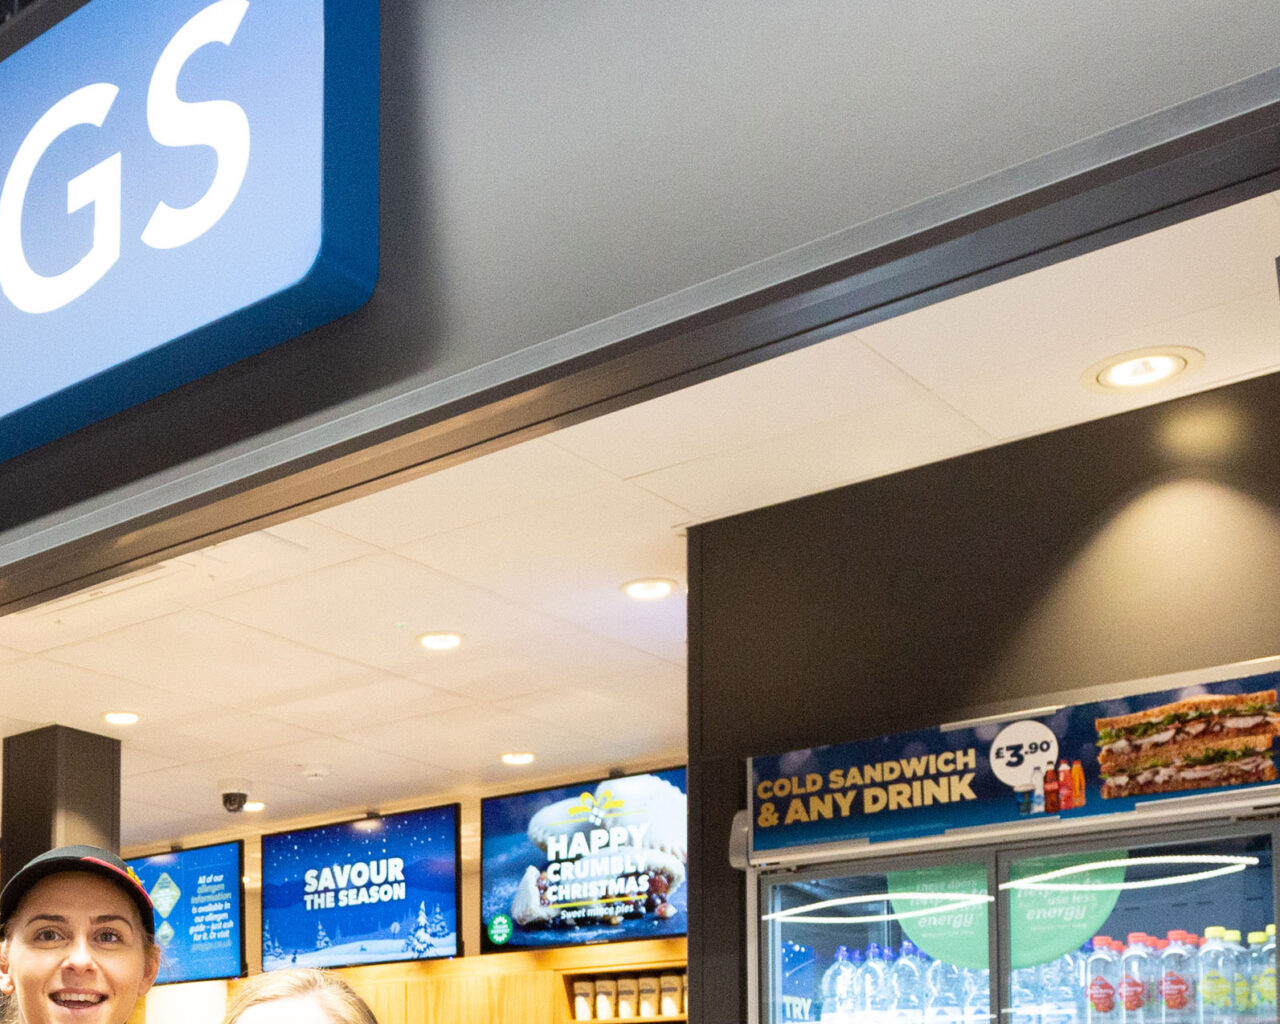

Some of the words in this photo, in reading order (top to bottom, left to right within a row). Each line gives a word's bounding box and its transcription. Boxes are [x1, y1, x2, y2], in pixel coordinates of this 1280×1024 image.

[756, 773, 823, 800] COLD
[828, 748, 976, 790] SANDWICH
[757, 802, 780, 828] &
[784, 789, 858, 825] ANY
[863, 773, 978, 815] DRINK
[546, 823, 649, 861] HAPPY
[304, 857, 405, 893] SAVOUR
[546, 854, 647, 882] CRUMBLY
[304, 891, 335, 911] THE
[337, 882, 406, 907] SEASON
[545, 874, 650, 901] CHRISTMAS
[561, 908, 586, 920] Sweet
[587, 907, 613, 918] mince
[614, 904, 635, 919] pies
[917, 912, 974, 929] energy
[1026, 905, 1087, 921] energy
[783, 994, 812, 1020] TRY
